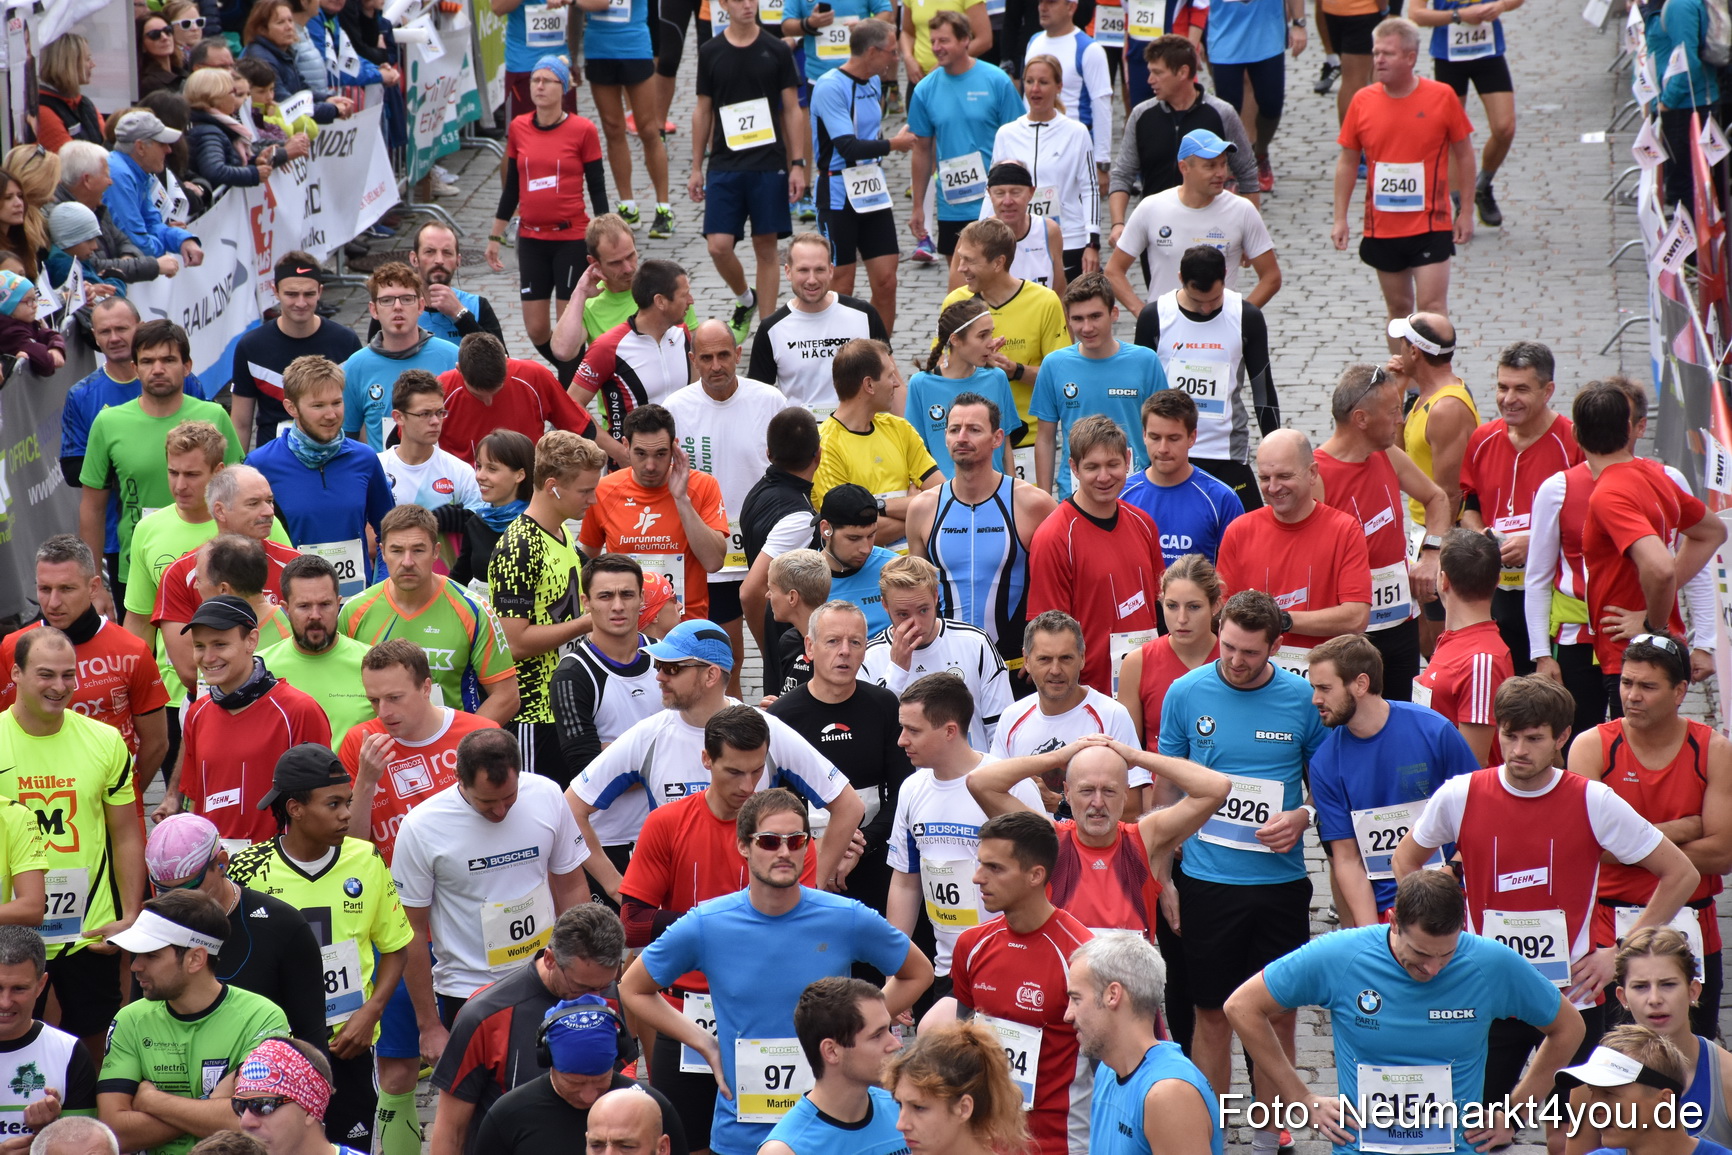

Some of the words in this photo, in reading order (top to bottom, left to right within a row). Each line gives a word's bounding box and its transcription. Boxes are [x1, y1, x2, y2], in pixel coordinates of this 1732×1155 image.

[532, 16, 561, 31] 2380
[1101, 17, 1124, 32] 249
[1136, 11, 1155, 25] 251
[829, 29, 846, 43] 59
[1455, 29, 1487, 45] 2144
[738, 115, 755, 131] 27
[945, 167, 979, 187] 2454
[852, 177, 882, 196] 2700
[1381, 177, 1417, 194] 2540
[1027, 200, 1051, 216] 767
[797, 337, 851, 349] INTERSPORT
[1185, 342, 1225, 350] KLEBL
[801, 348, 835, 359] HÄCK
[1107, 388, 1138, 397] BOCK
[1176, 376, 1217, 397] 2051
[9, 433, 41, 475] OFFICE
[1372, 514, 1385, 529] DEHN
[1504, 519, 1520, 527] DEHN
[619, 534, 671, 546] funrunners
[634, 541, 679, 551] neumarkt
[732, 533, 744, 551] 9
[732, 554, 747, 564] Sieg
[334, 559, 356, 580] 28
[861, 594, 882, 606] THU
[1372, 582, 1401, 607] 151
[1375, 610, 1392, 620] Peter
[78, 654, 140, 679] raum
[71, 697, 107, 717] ox
[820, 732, 853, 742] skinfit
[1255, 730, 1293, 742] BOCK
[17, 775, 77, 790] Müller
[211, 794, 229, 805] DEHN
[928, 824, 979, 838] BÜSCHEL
[490, 848, 537, 866] BÜSCHEL
[1511, 874, 1535, 885] DEHN
[343, 900, 364, 910] Partl
[509, 914, 536, 941] 60
[1510, 918, 1541, 927] BOCK
[507, 939, 541, 958] Wolfgang
[1355, 1016, 1380, 1027] PARTL
[1429, 1009, 1476, 1020] BOCK
[1354, 1022, 1380, 1031] Neumarkt
[764, 1064, 796, 1091] 97
[1390, 1073, 1424, 1082] BOCK
[766, 1098, 796, 1109] Martin
[346, 1129, 369, 1140] adidas
[1387, 1128, 1424, 1139] Markus
